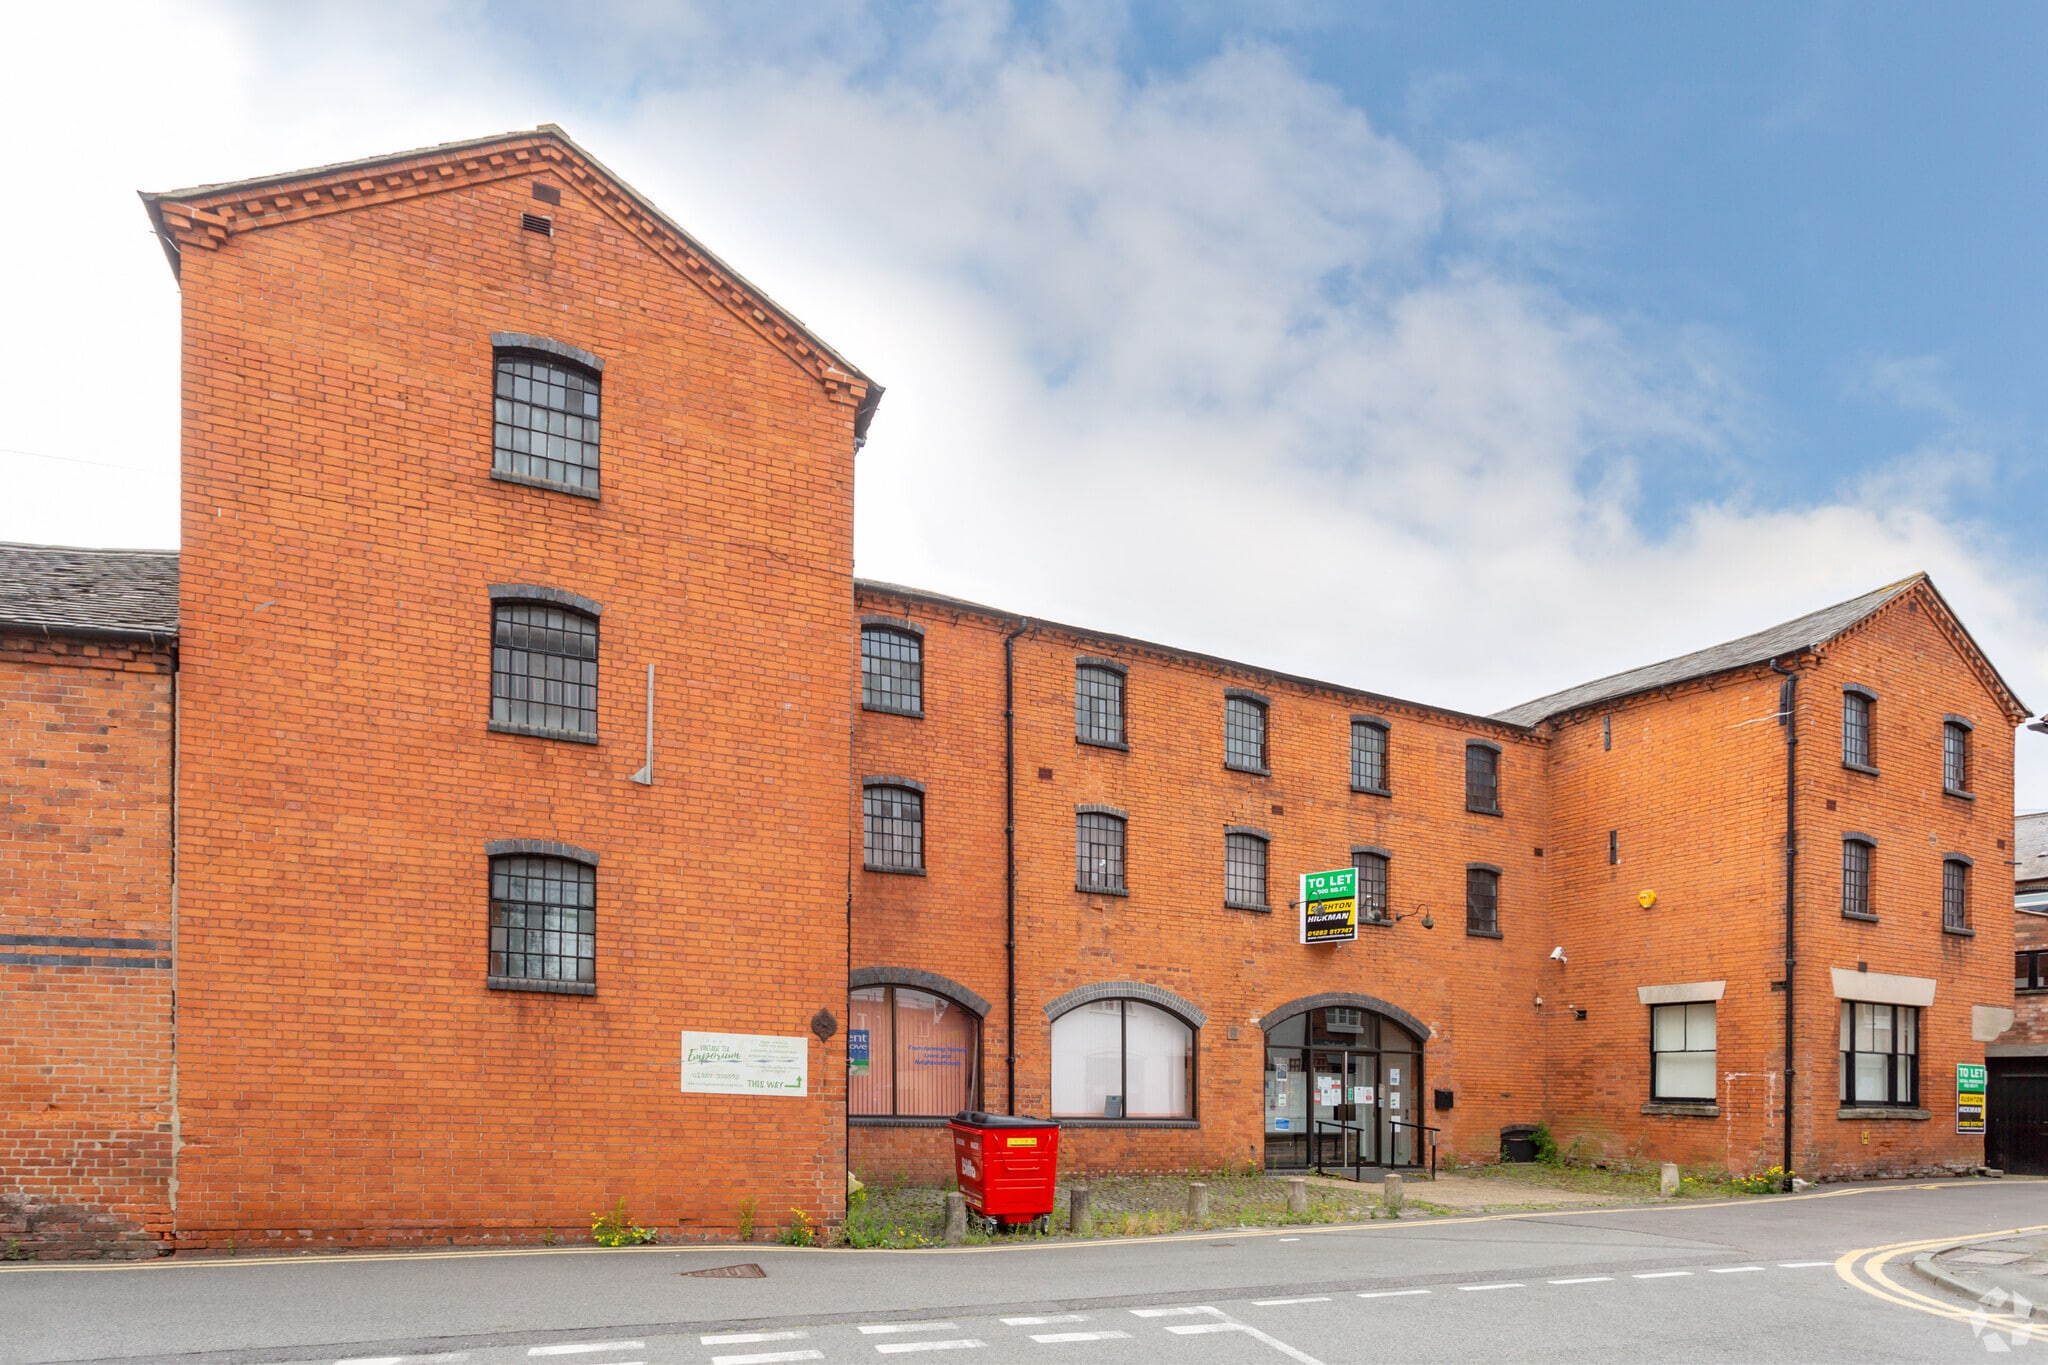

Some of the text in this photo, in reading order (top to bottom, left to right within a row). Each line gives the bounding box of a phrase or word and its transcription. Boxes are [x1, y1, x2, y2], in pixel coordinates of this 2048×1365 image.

[1308, 874, 1352, 889] TO LET
[1307, 912, 1349, 922] HICKMAN
[699, 1044, 720, 1052] VINTAGE
[687, 1048, 741, 1065] Emporium
[1959, 1067, 1984, 1078] TO LET
[747, 1080, 765, 1088] THIS
[766, 1081, 784, 1089] WAY
